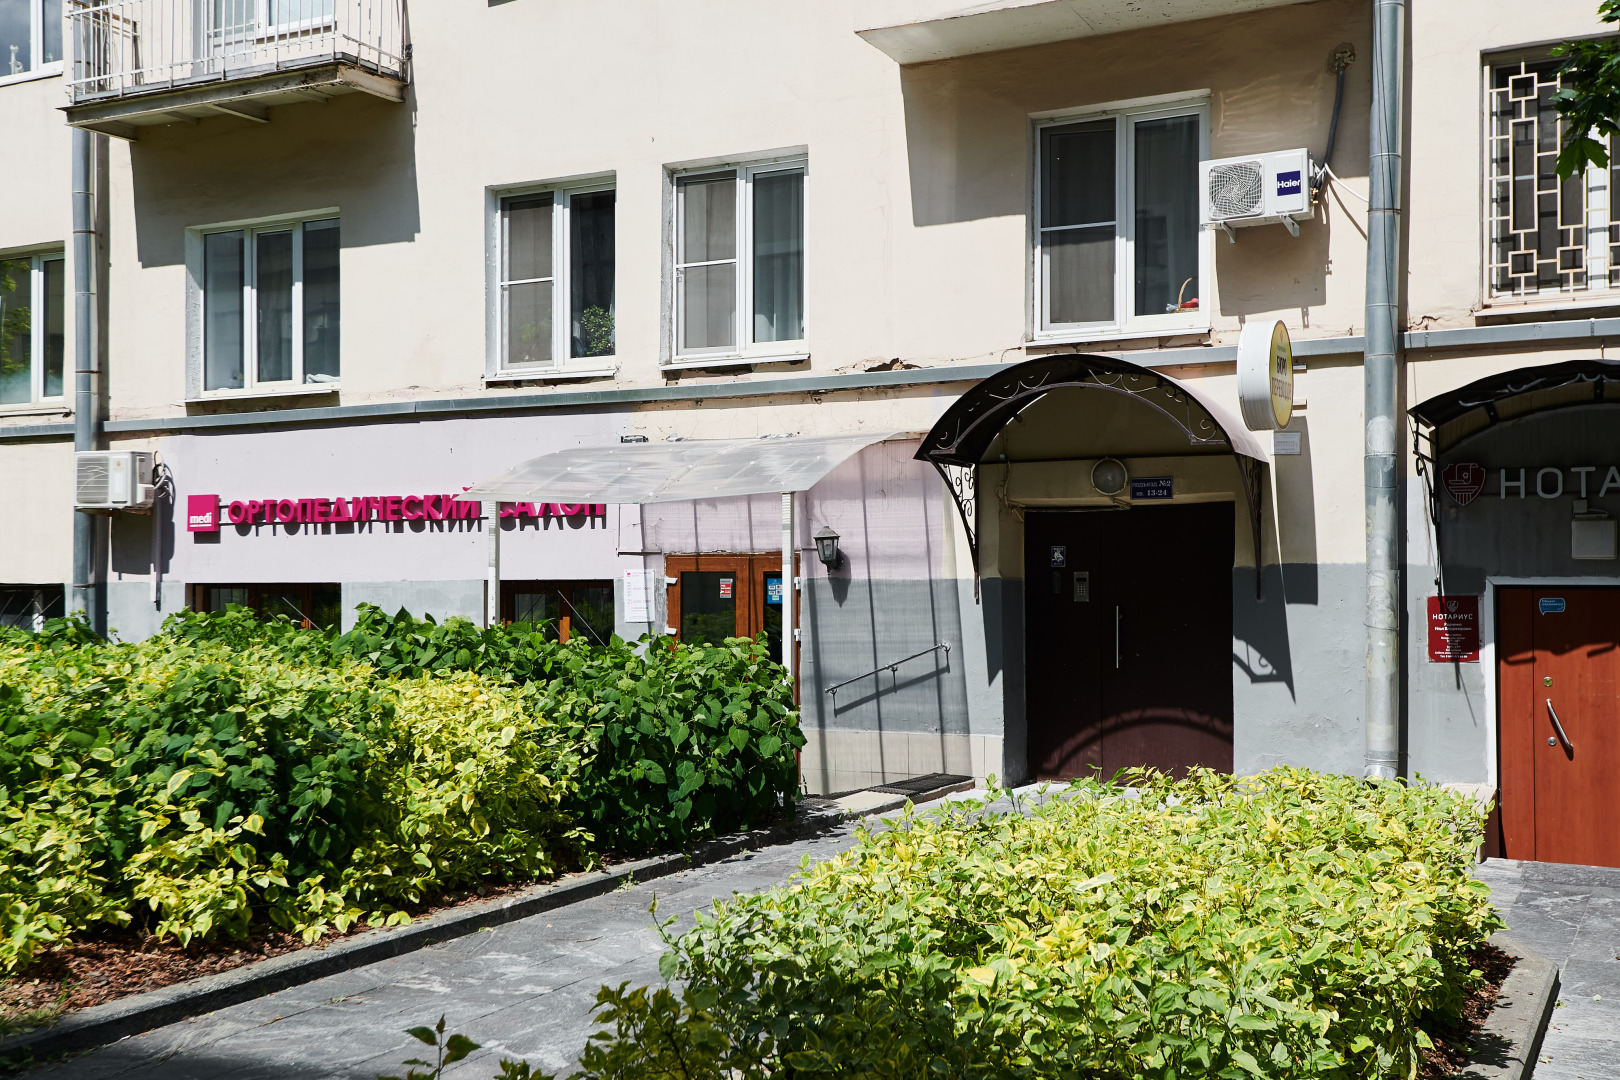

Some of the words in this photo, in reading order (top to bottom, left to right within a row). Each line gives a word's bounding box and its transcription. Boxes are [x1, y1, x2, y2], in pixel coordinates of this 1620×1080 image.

[1277, 179, 1300, 189] Haier
[1276, 356, 1287, 377] БЮРО
[1500, 465, 1620, 499] НОТА
[227, 487, 481, 523] ОРТОПЕДИЧЕСКИЙ
[189, 512, 213, 524] medi
